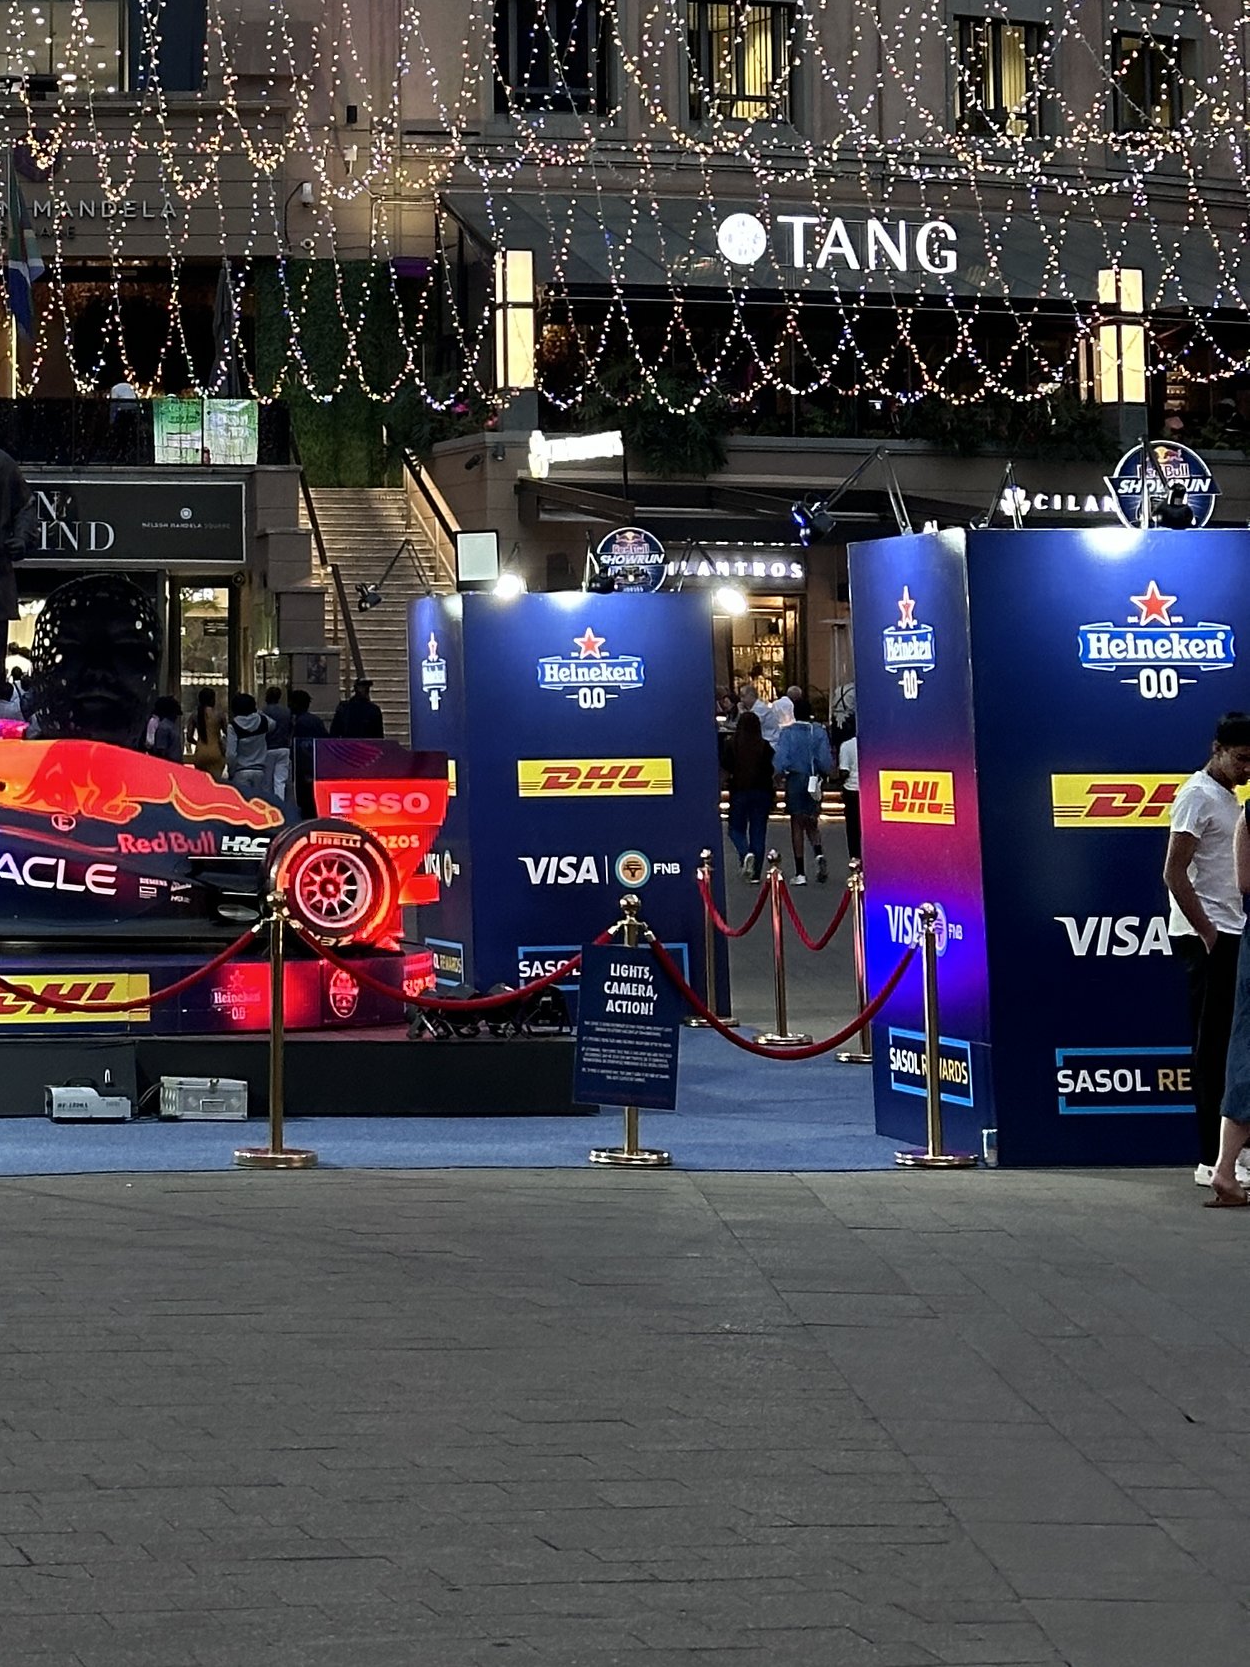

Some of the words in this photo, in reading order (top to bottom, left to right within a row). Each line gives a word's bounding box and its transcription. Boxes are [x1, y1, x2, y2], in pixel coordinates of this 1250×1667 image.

[33, 200, 178, 218] MANDELA
[777, 215, 957, 274] TANG
[600, 554, 664, 565] SHOWRUN
[1086, 632, 1226, 659] Heineken
[544, 662, 639, 682] Heineken
[1139, 668, 1179, 699] 0.0
[578, 687, 606, 708] 0.0
[540, 766, 652, 790] DHL
[330, 792, 430, 815] ESSO
[890, 780, 944, 814] DHL
[117, 831, 169, 854] Red
[170, 831, 217, 854] Bull
[221, 836, 271, 852] HRC
[310, 830, 362, 848] PIRELLI
[518, 856, 600, 885] VISA
[653, 863, 681, 875] FNB
[1054, 916, 1173, 956] VISA
[610, 963, 654, 982] LIGHTS,
[603, 981, 658, 1000] CAMERA,
[605, 999, 654, 1016] ACTION!
[890, 1047, 921, 1076] SASOL
[921, 1053, 969, 1085] RARDS
[1057, 1069, 1151, 1093] SASOL
